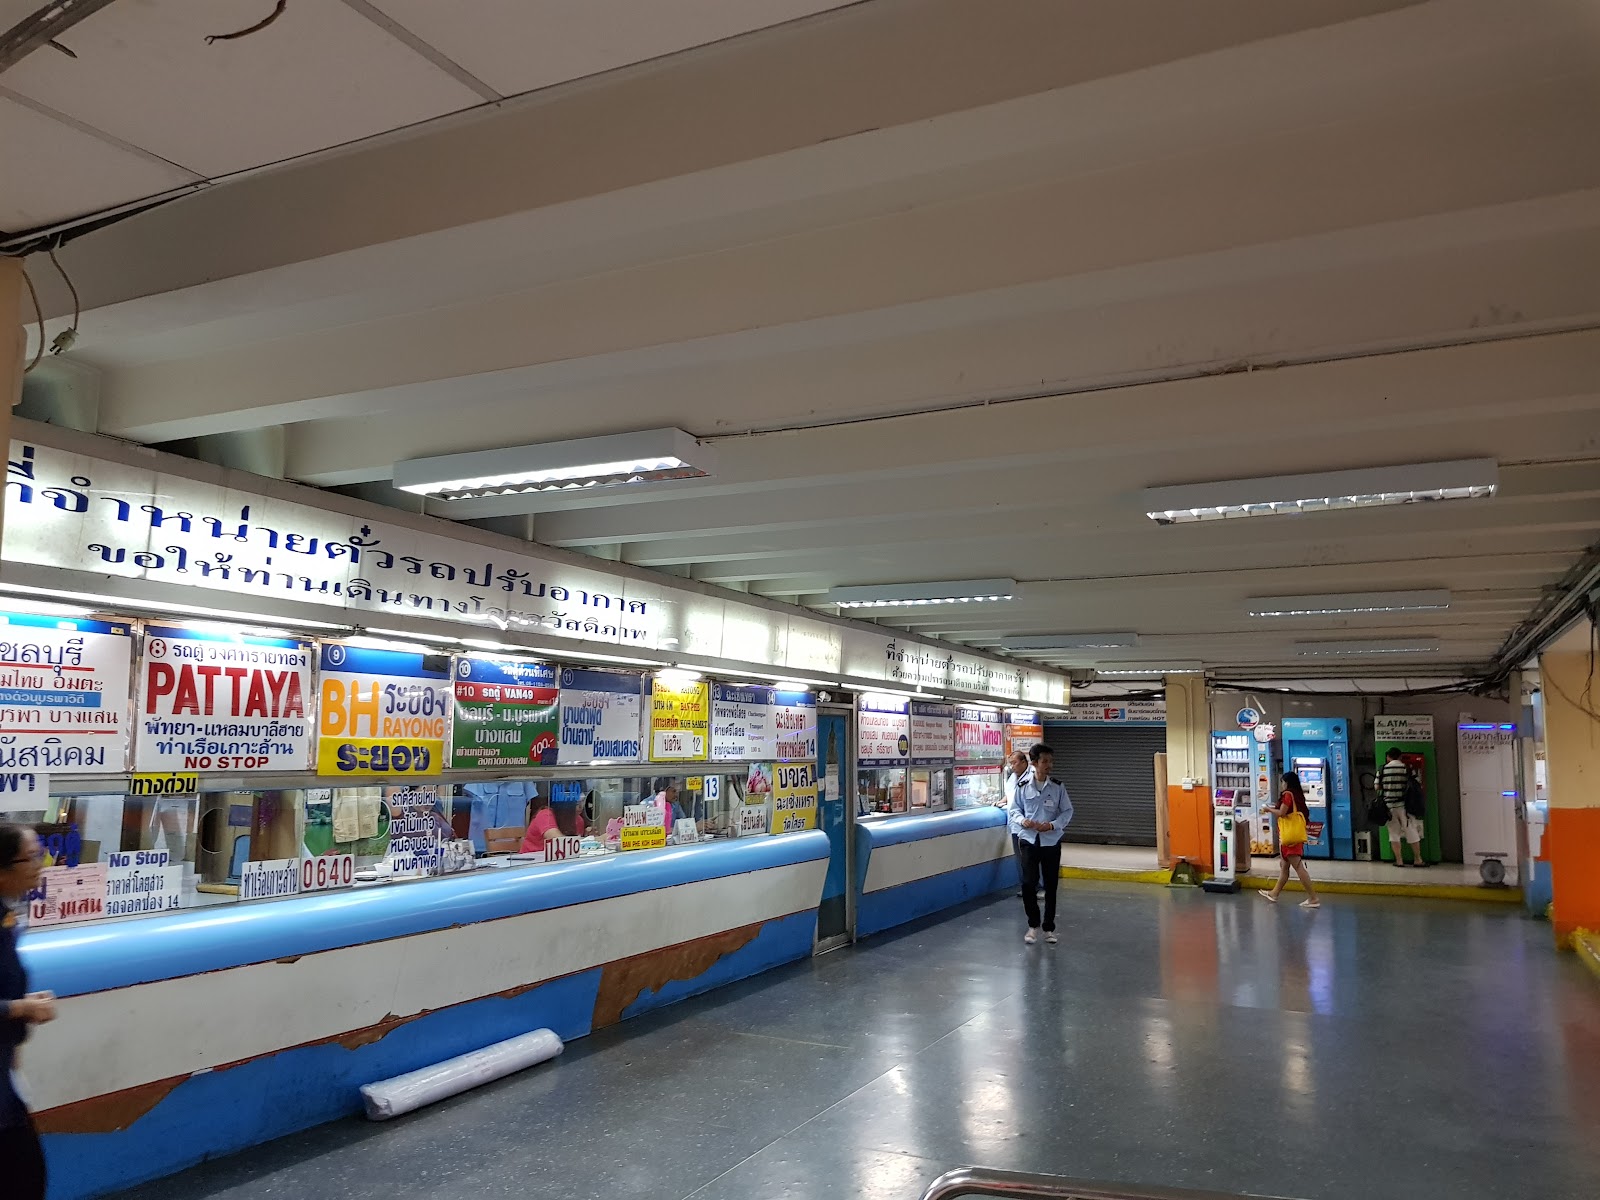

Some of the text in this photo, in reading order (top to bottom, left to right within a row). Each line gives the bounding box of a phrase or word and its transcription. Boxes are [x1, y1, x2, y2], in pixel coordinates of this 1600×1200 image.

[146, 661, 304, 718] PATTAYA
[456, 685, 533, 701] #10 รถตู้ VAN49
[321, 679, 380, 737] BH
[384, 683, 447, 716] ระยอง
[50, 709, 118, 724] บางแสน
[460, 704, 494, 725] ชลบุรี
[960, 709, 979, 720] EAGLES
[1386, 719, 1408, 727] ATM
[383, 717, 445, 738] RAYONG
[475, 729, 522, 743] บางแสน
[955, 721, 981, 745] PATTAYA
[1302, 728, 1319, 736] ATM
[156, 737, 294, 756] ท่าเรือเกาะล้าน
[692, 736, 701, 752] 12
[806, 738, 815, 756] 14
[184, 756, 269, 769] NO STOP
[336, 743, 430, 771] ระยอง
[132, 772, 197, 794] ทางด่วน
[777, 765, 813, 788] บขส.
[706, 777, 718, 798] 13
[776, 792, 815, 811] ฉะเชิงเทรา
[109, 851, 168, 868] No Stop
[303, 856, 352, 888] 0640
[168, 894, 179, 908] 14
